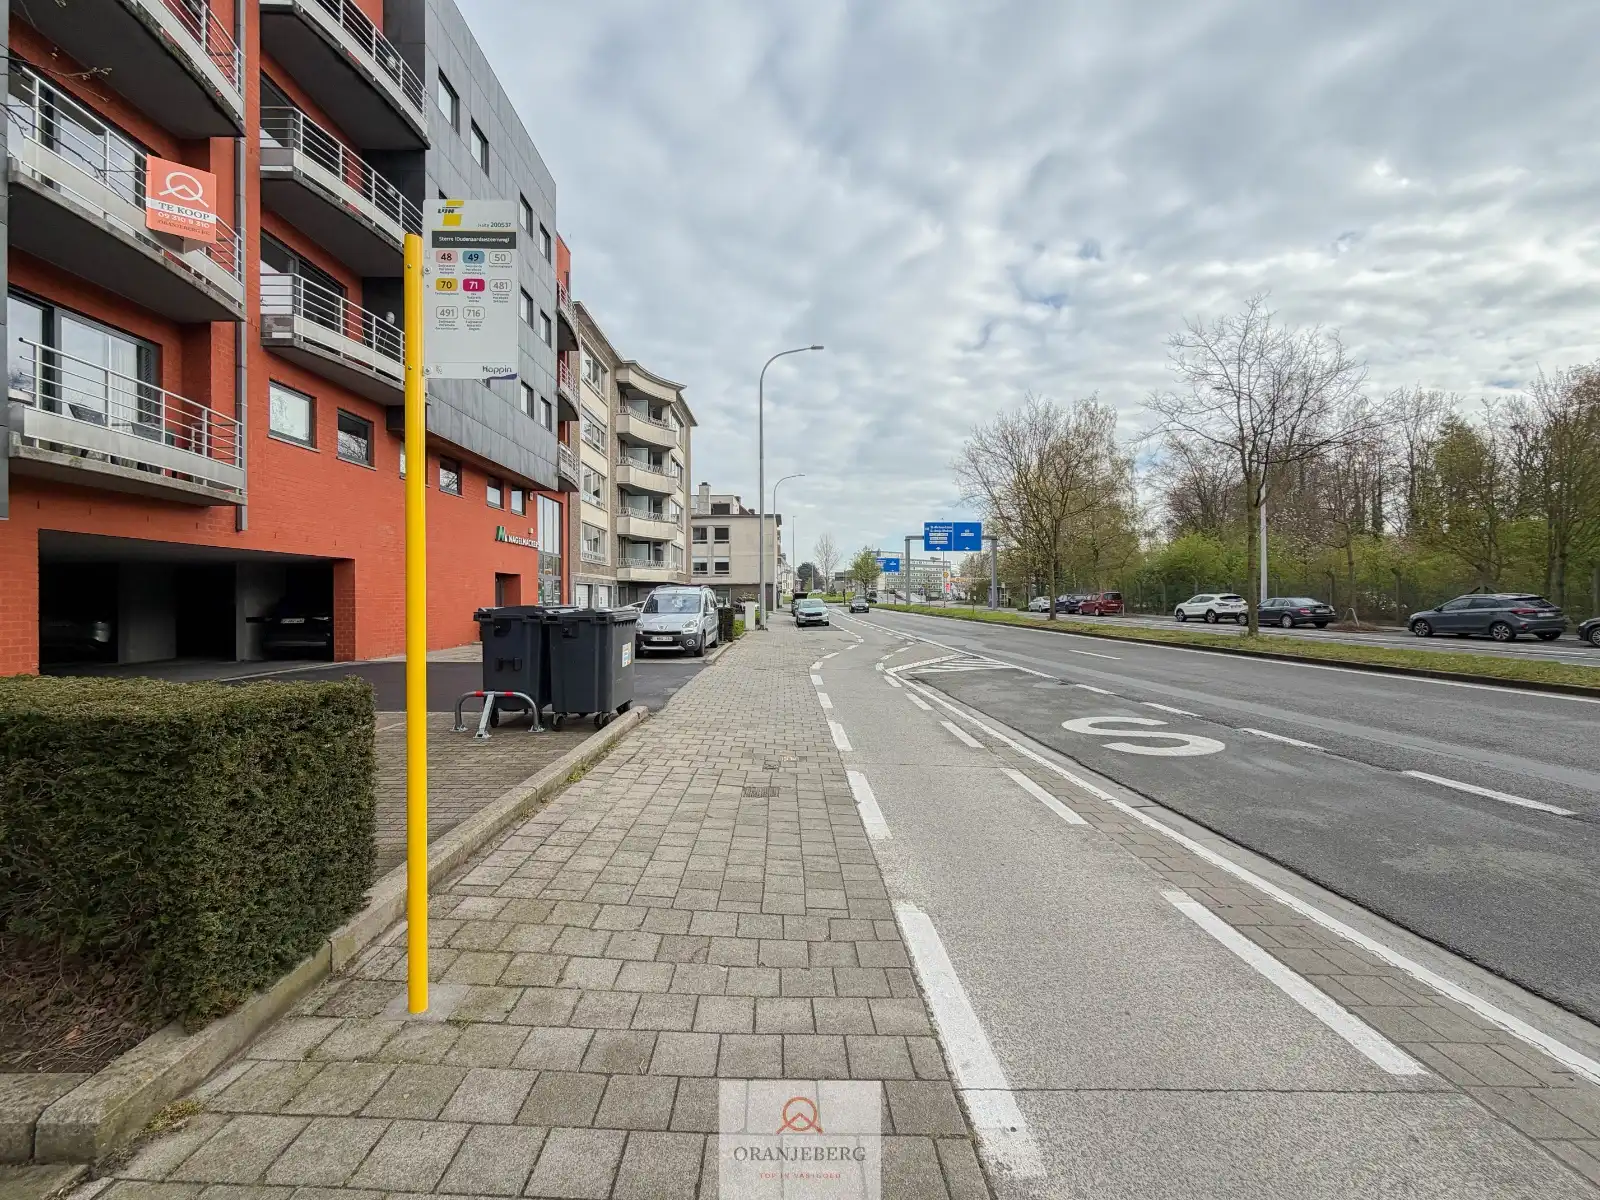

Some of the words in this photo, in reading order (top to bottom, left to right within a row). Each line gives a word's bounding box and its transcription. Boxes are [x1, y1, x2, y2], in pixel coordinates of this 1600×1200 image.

[158, 201, 174, 211] TE
[177, 207, 210, 220] KOOP
[440, 252, 453, 261] 48
[467, 253, 479, 262] 49
[494, 253, 506, 262] 50
[441, 280, 452, 289] 70
[469, 281, 478, 290] 71
[492, 281, 508, 290] 481
[439, 308, 455, 317] 491
[466, 309, 481, 318] 716
[482, 364, 512, 377] Hoppin
